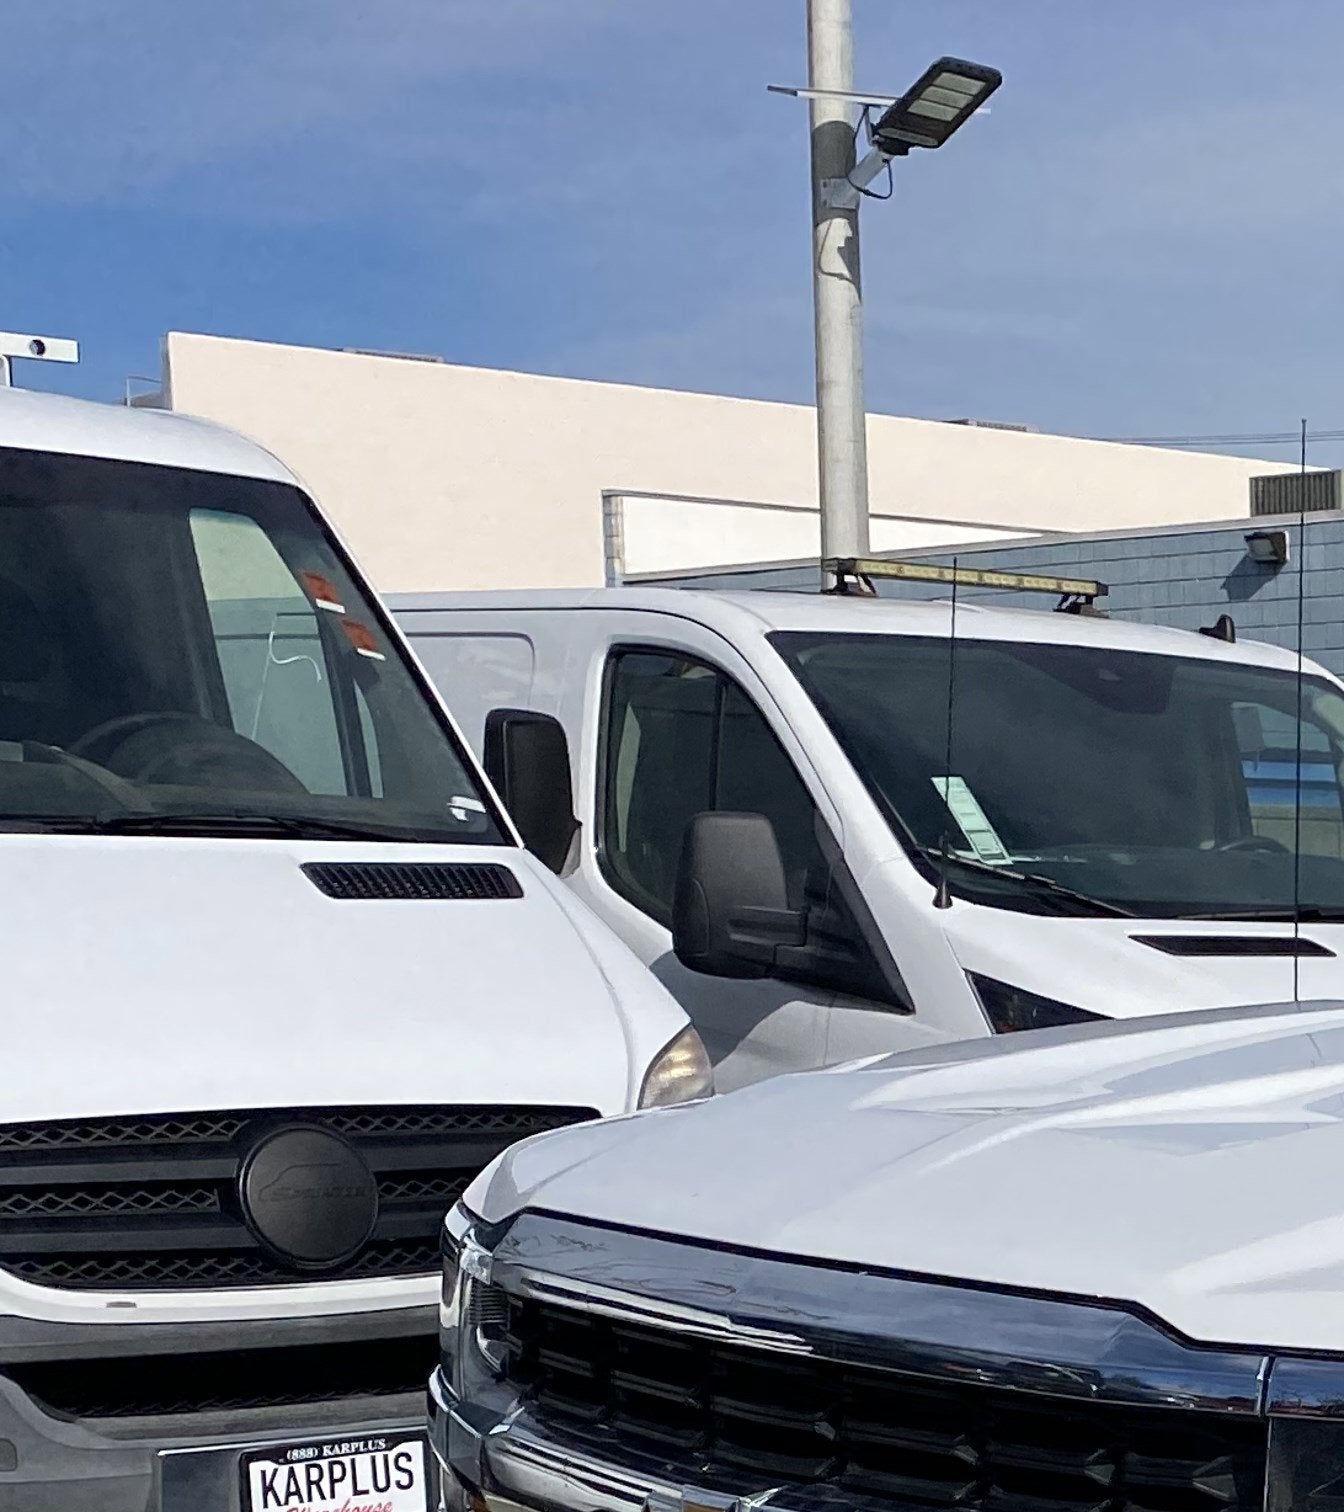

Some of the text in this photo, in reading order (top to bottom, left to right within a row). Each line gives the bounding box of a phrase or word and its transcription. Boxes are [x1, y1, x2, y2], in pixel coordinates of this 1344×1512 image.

[286, 1439, 386, 1461] (888) KARPLUS
[260, 1451, 414, 1509] KARPLUS
